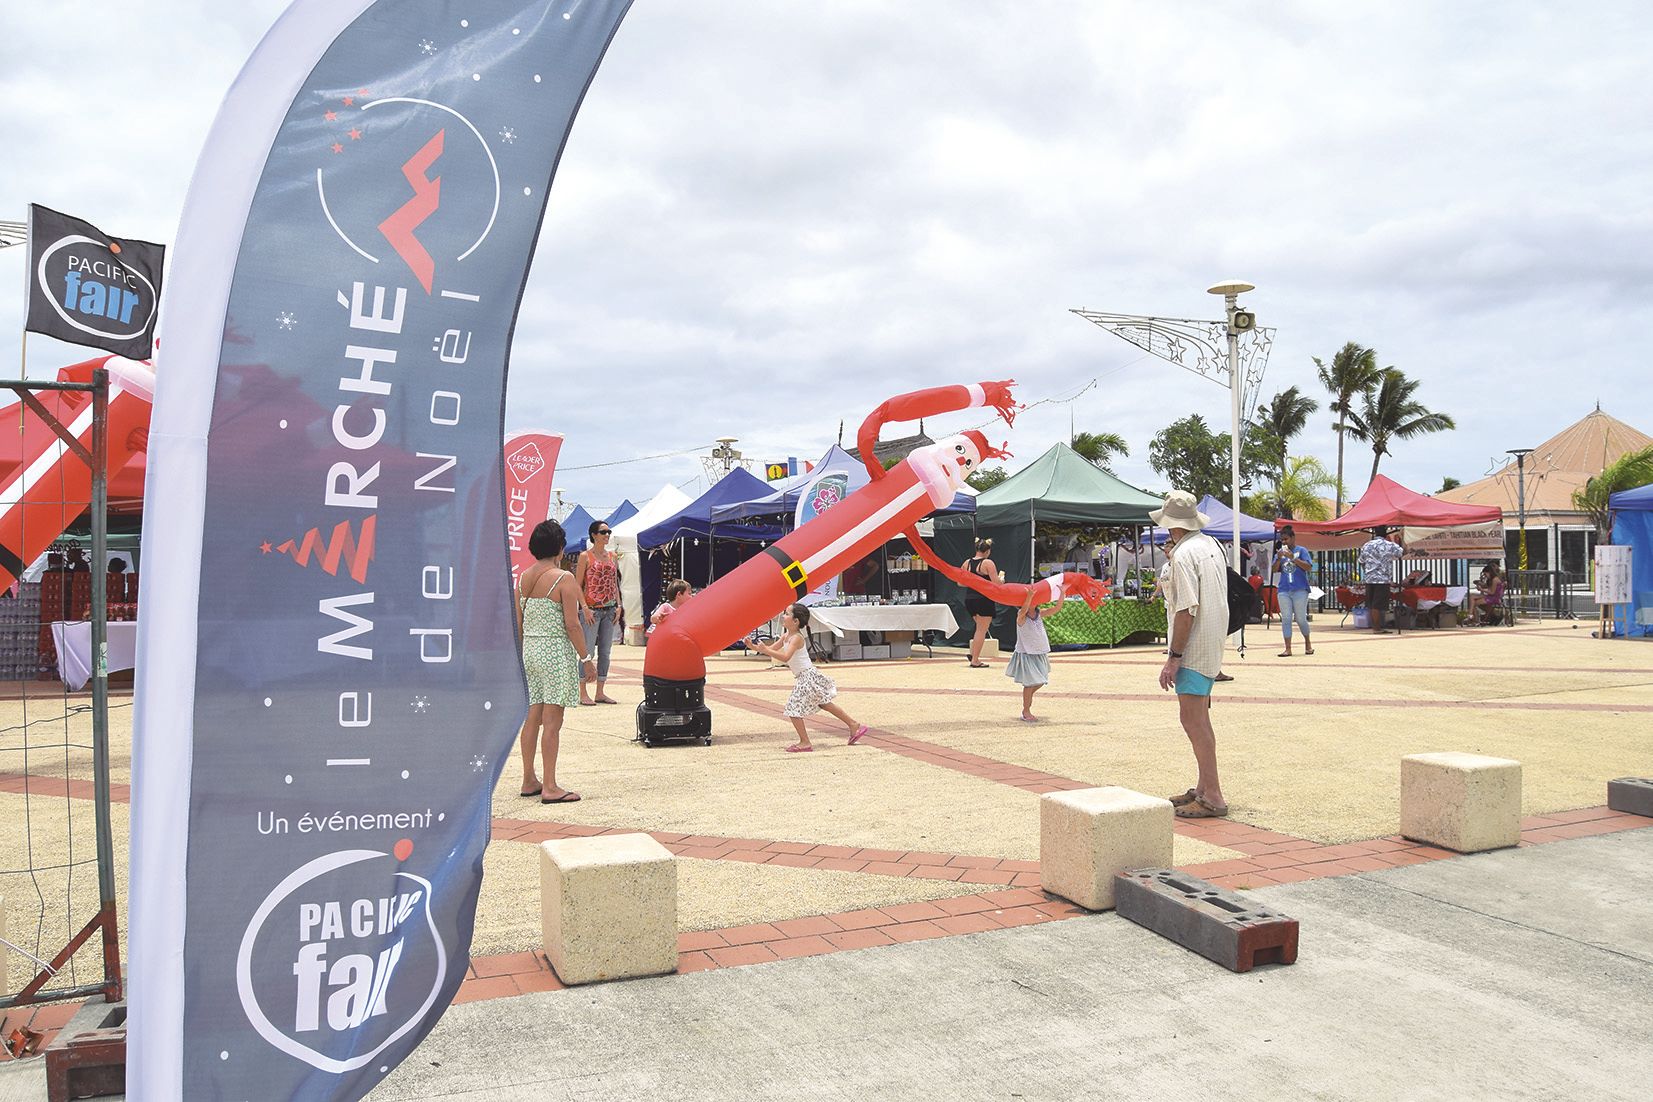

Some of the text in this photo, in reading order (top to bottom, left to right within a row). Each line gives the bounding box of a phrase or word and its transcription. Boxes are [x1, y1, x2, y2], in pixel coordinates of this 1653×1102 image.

[64, 271, 139, 324] fair
[68, 255, 138, 290] PACIFIC
[409, 289, 480, 664] de Noël
[512, 454, 541, 465] LEADER
[513, 462, 535, 473] PRICE
[507, 488, 528, 551] PRICE
[326, 691, 372, 766] le
[257, 808, 433, 834] Un événement
[299, 890, 423, 942] PACIFIC
[293, 937, 405, 1032] fair
